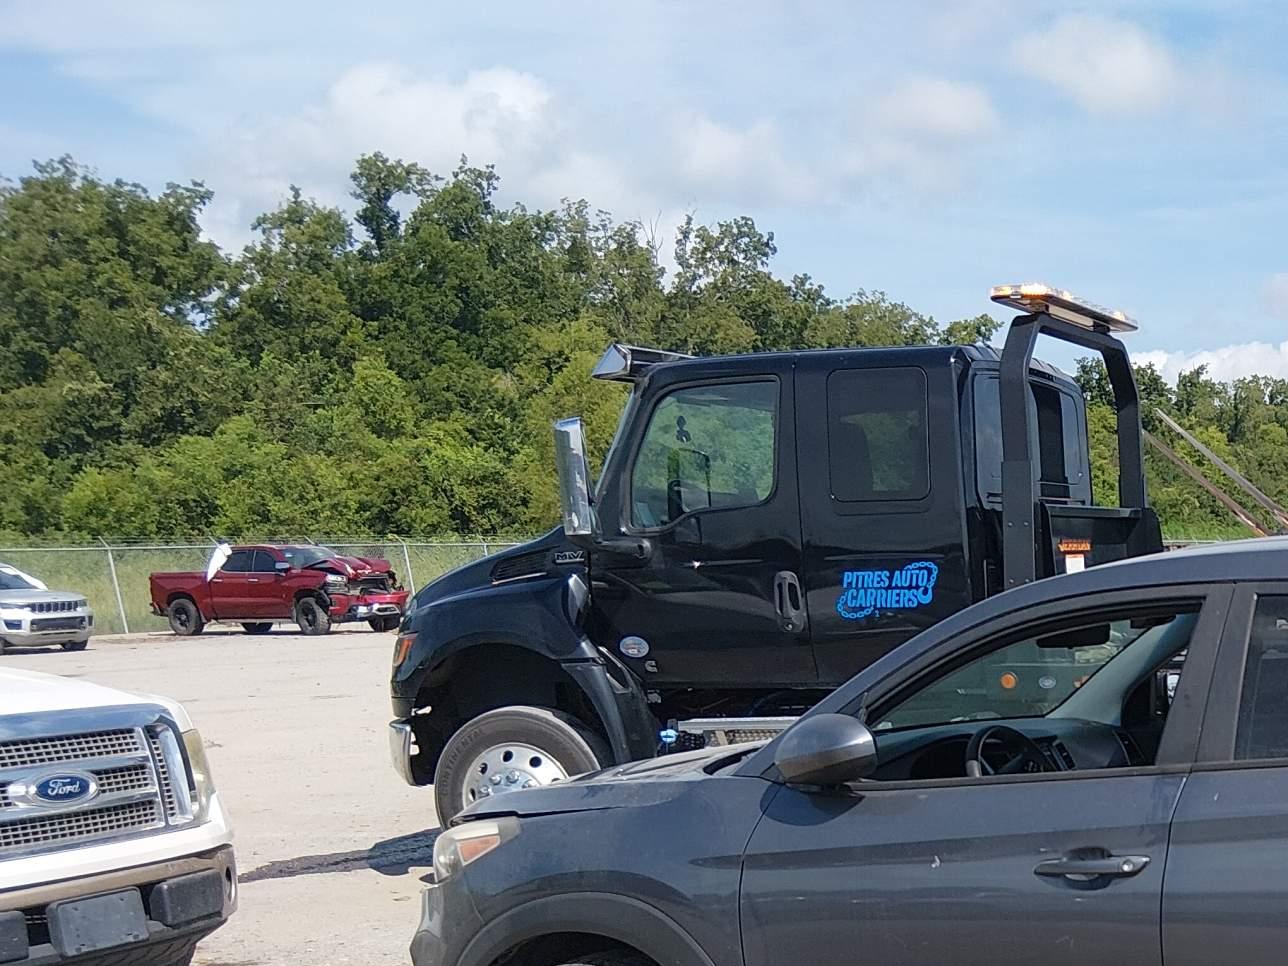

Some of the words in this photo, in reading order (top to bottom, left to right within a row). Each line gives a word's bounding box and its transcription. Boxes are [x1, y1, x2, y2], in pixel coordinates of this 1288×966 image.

[554, 550, 584, 561] MV
[843, 571, 890, 588] PITRES
[891, 569, 928, 587] AUTO
[847, 588, 918, 608] CARRIERS
[47, 778, 81, 796] Ford
